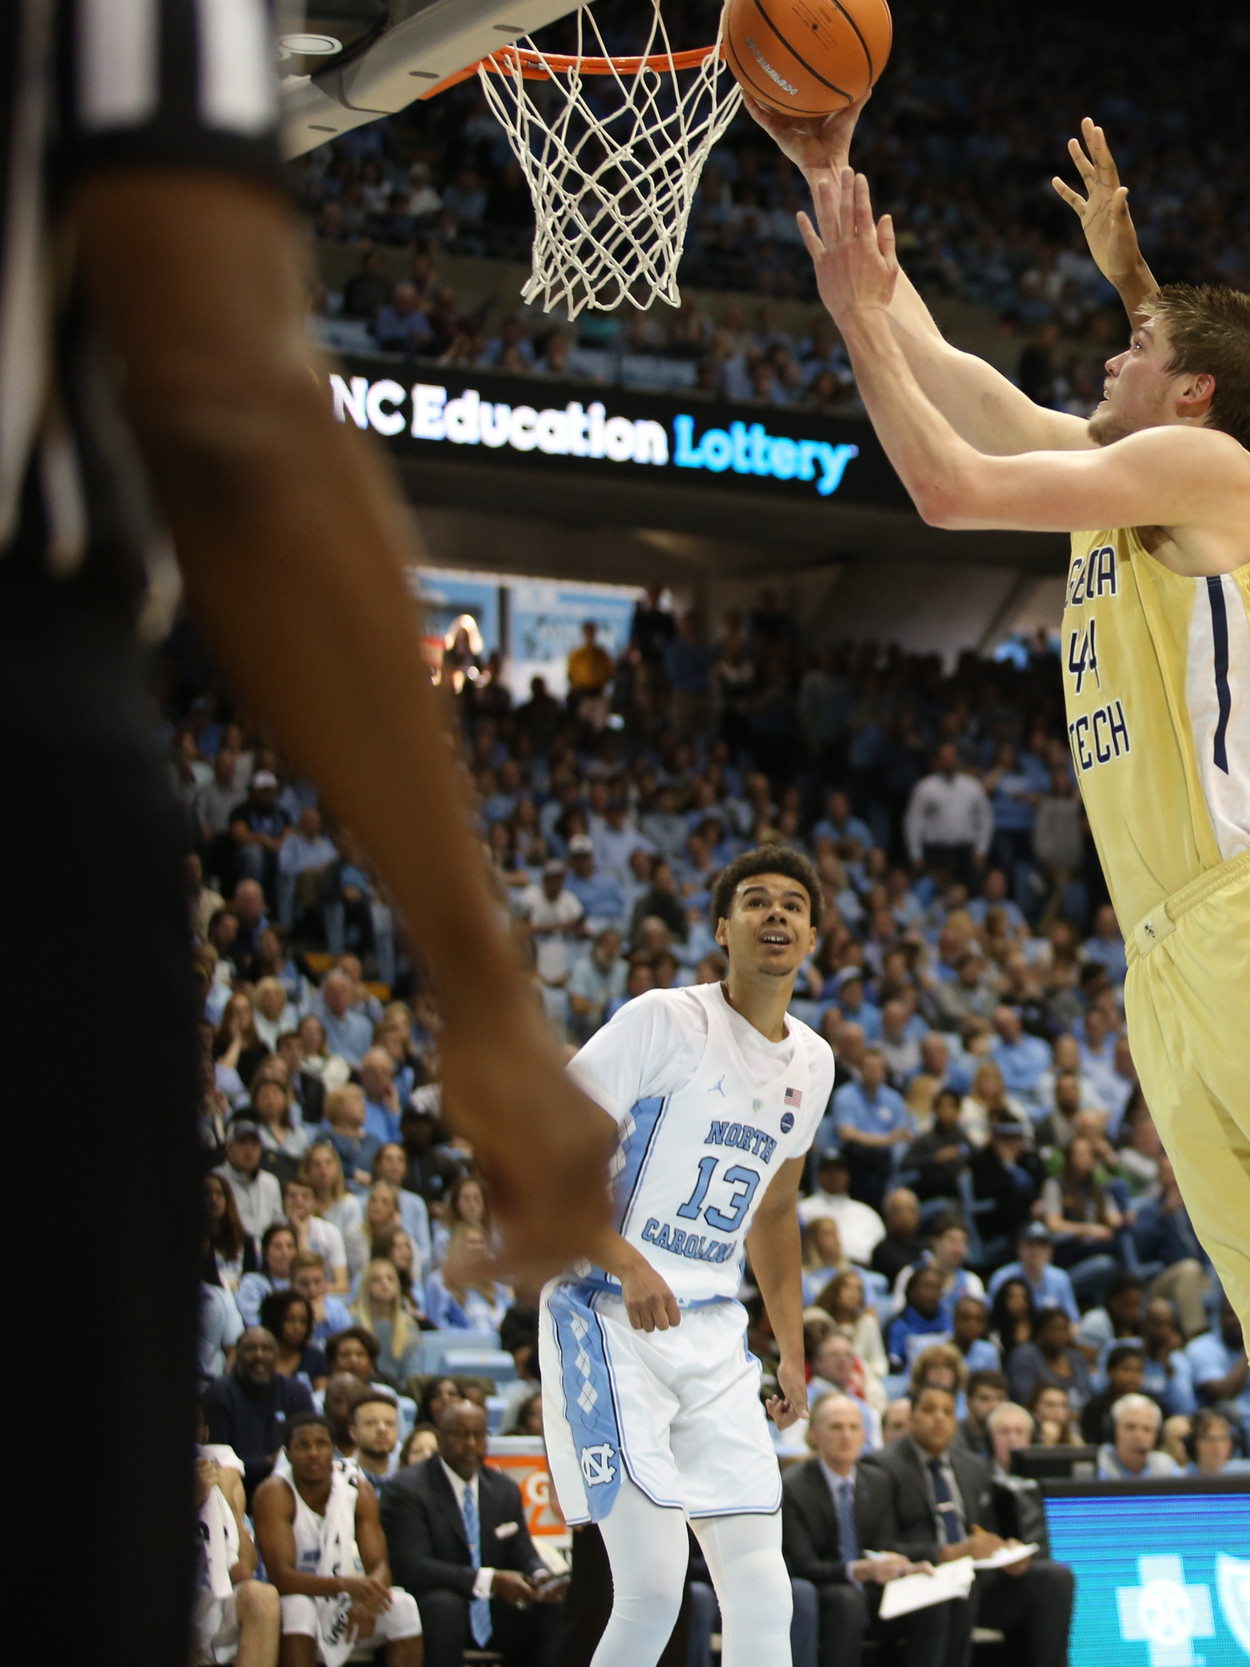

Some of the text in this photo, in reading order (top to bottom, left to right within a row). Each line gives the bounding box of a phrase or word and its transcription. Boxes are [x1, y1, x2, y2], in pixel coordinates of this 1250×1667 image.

[329, 374, 852, 496] NC Education Lottery
[1069, 698, 1131, 774] TECH
[704, 1120, 778, 1165] NORTH
[676, 1155, 761, 1234] 13
[641, 1217, 738, 1264] CAROLIN
